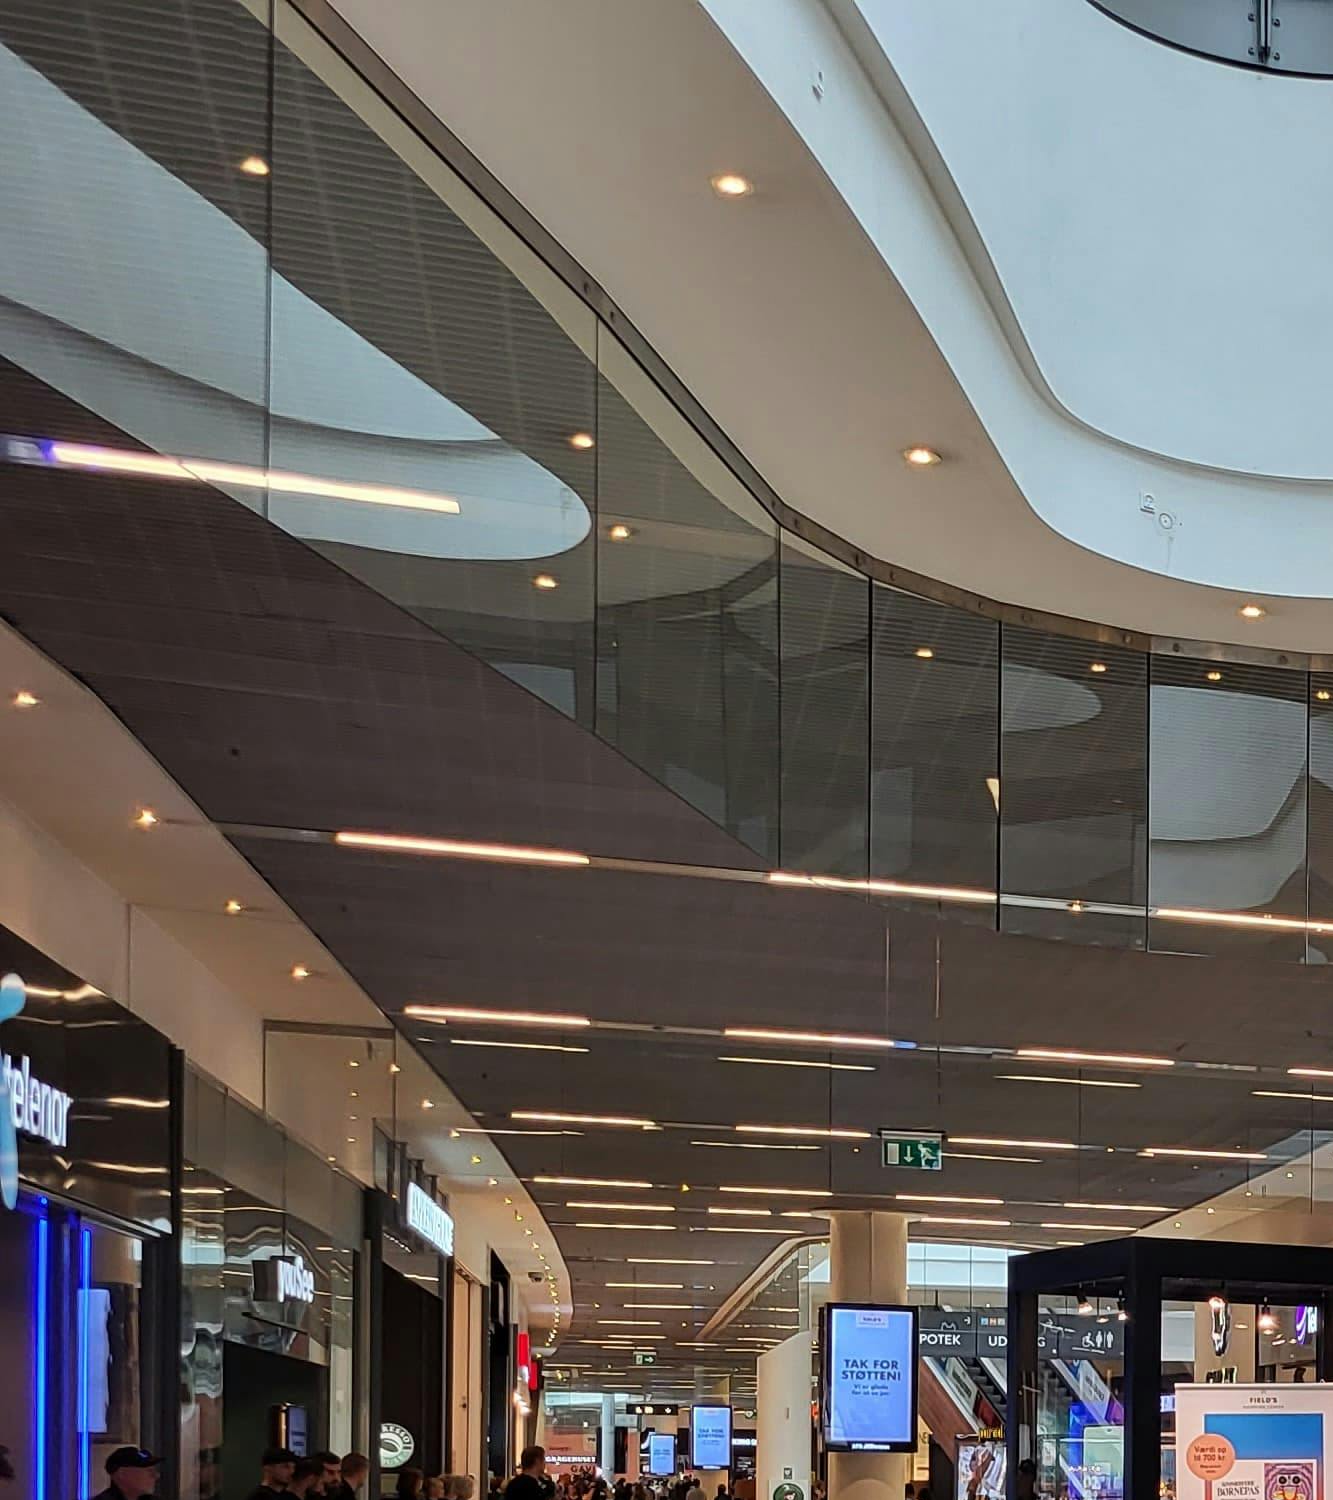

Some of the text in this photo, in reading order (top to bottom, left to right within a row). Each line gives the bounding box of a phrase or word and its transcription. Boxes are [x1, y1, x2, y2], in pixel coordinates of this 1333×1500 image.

[2, 1053, 74, 1147] telenor
[919, 1334, 961, 1345] POTEK
[843, 1360, 899, 1370] TAK FOR
